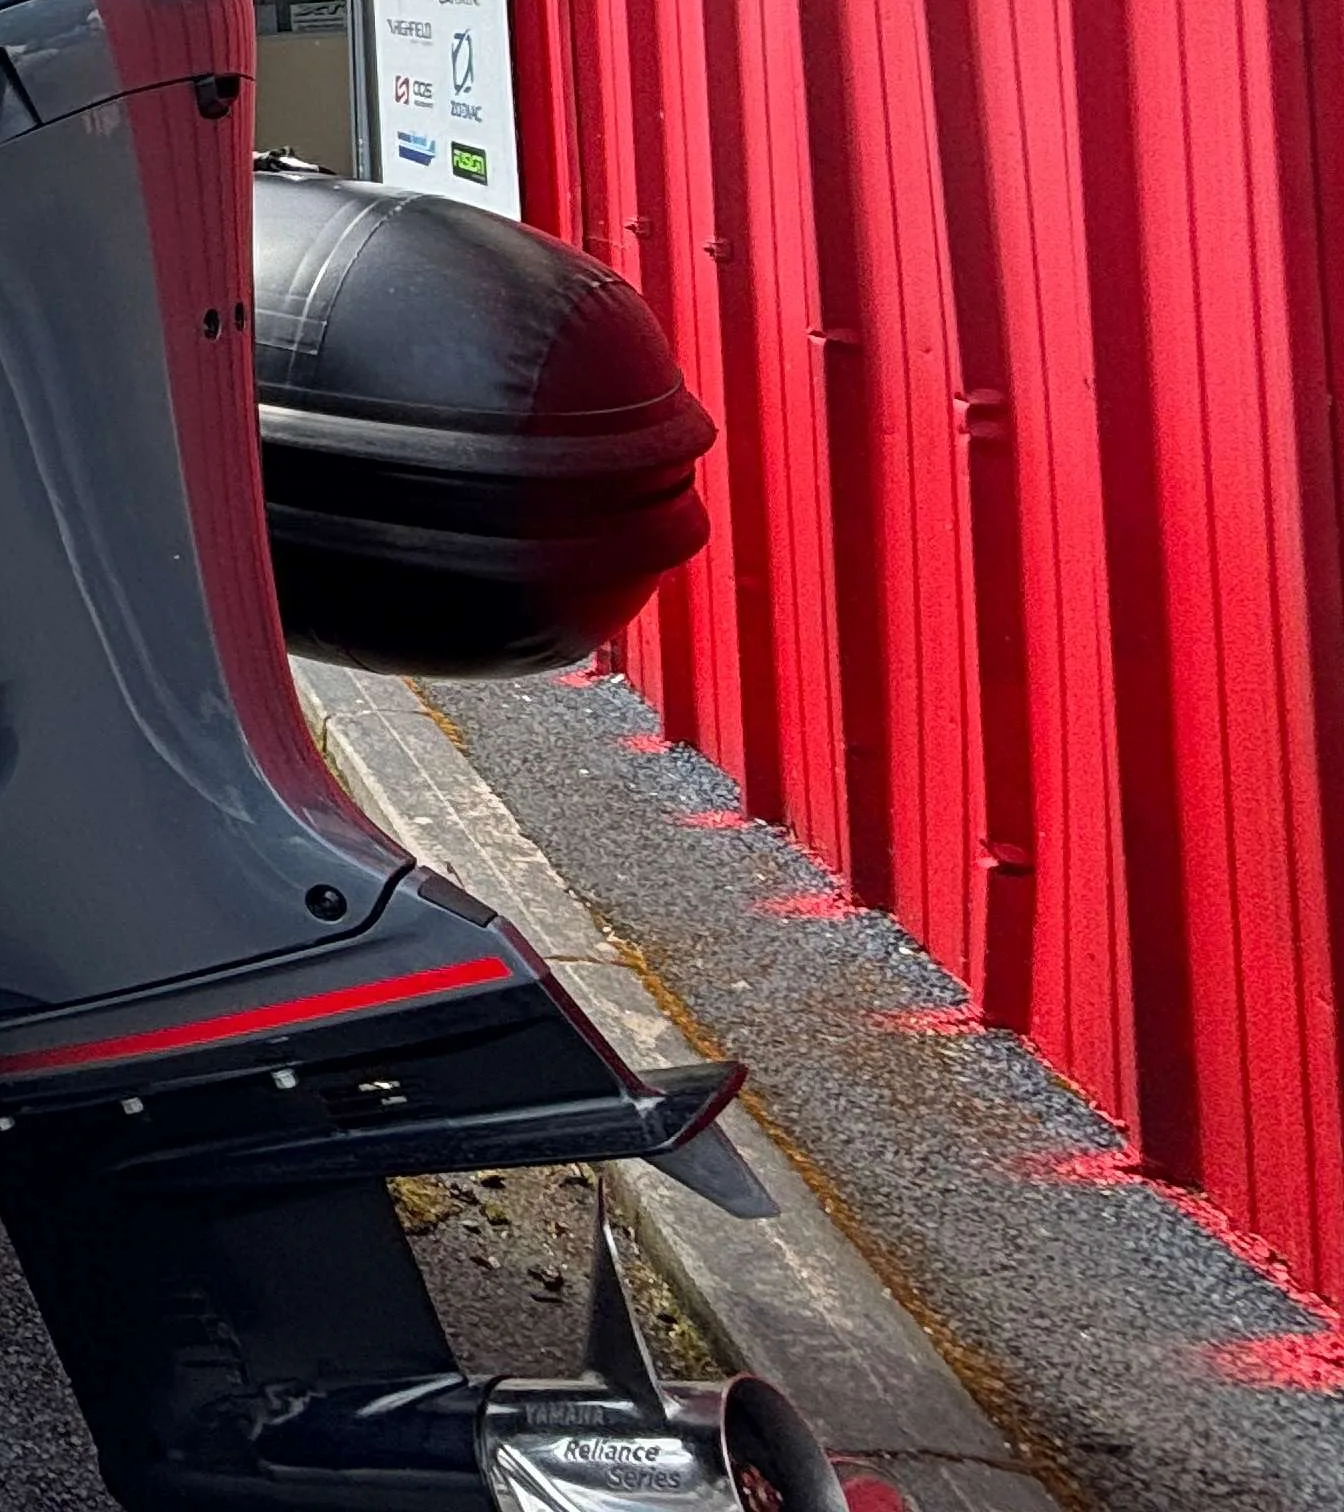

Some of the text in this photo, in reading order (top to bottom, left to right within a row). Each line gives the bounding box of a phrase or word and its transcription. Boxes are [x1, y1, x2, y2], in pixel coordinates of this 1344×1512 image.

[525, 1402, 605, 1426] YAMAHA
[563, 1438, 661, 1463] Reliance
[607, 1466, 682, 1489] Series
